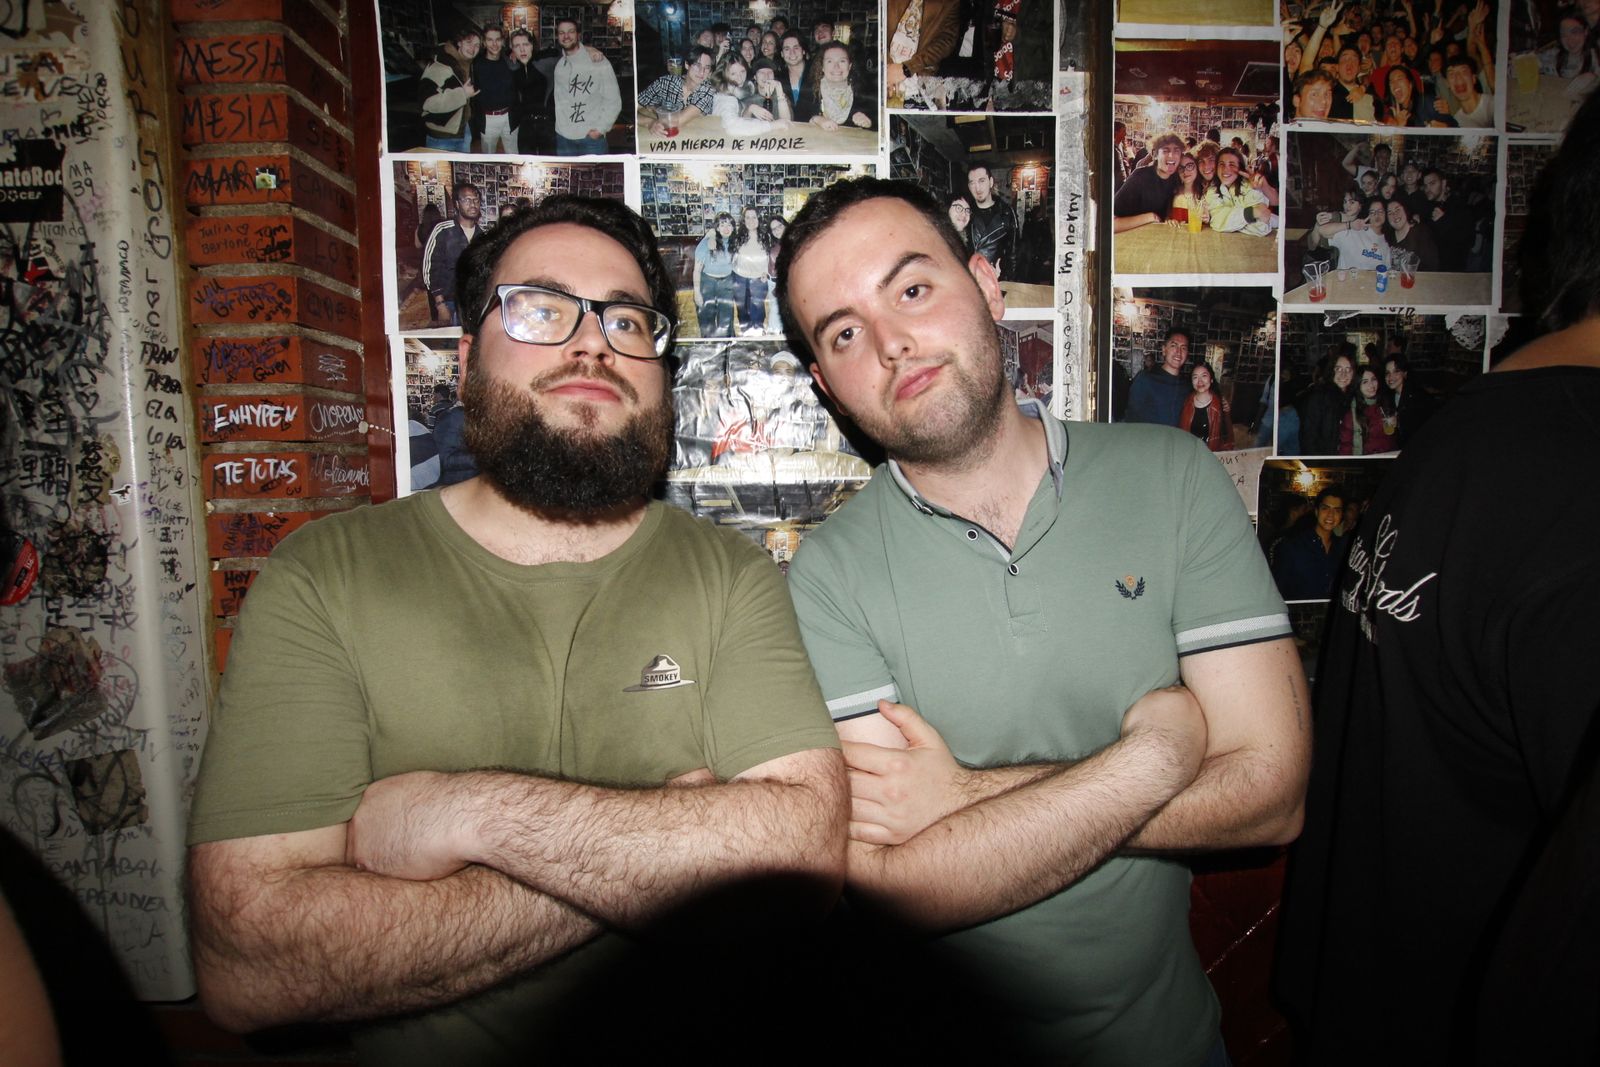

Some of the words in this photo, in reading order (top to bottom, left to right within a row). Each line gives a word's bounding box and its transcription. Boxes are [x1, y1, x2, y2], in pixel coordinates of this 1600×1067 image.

[650, 140, 677, 152] VAYA
[681, 138, 725, 151] MIERDA
[732, 139, 745, 151] DE
[750, 137, 805, 151] MADRIZ
[1063, 192, 1082, 246] horny
[213, 403, 299, 432] ENHYPEN
[644, 672, 678, 683] SMOKEY
